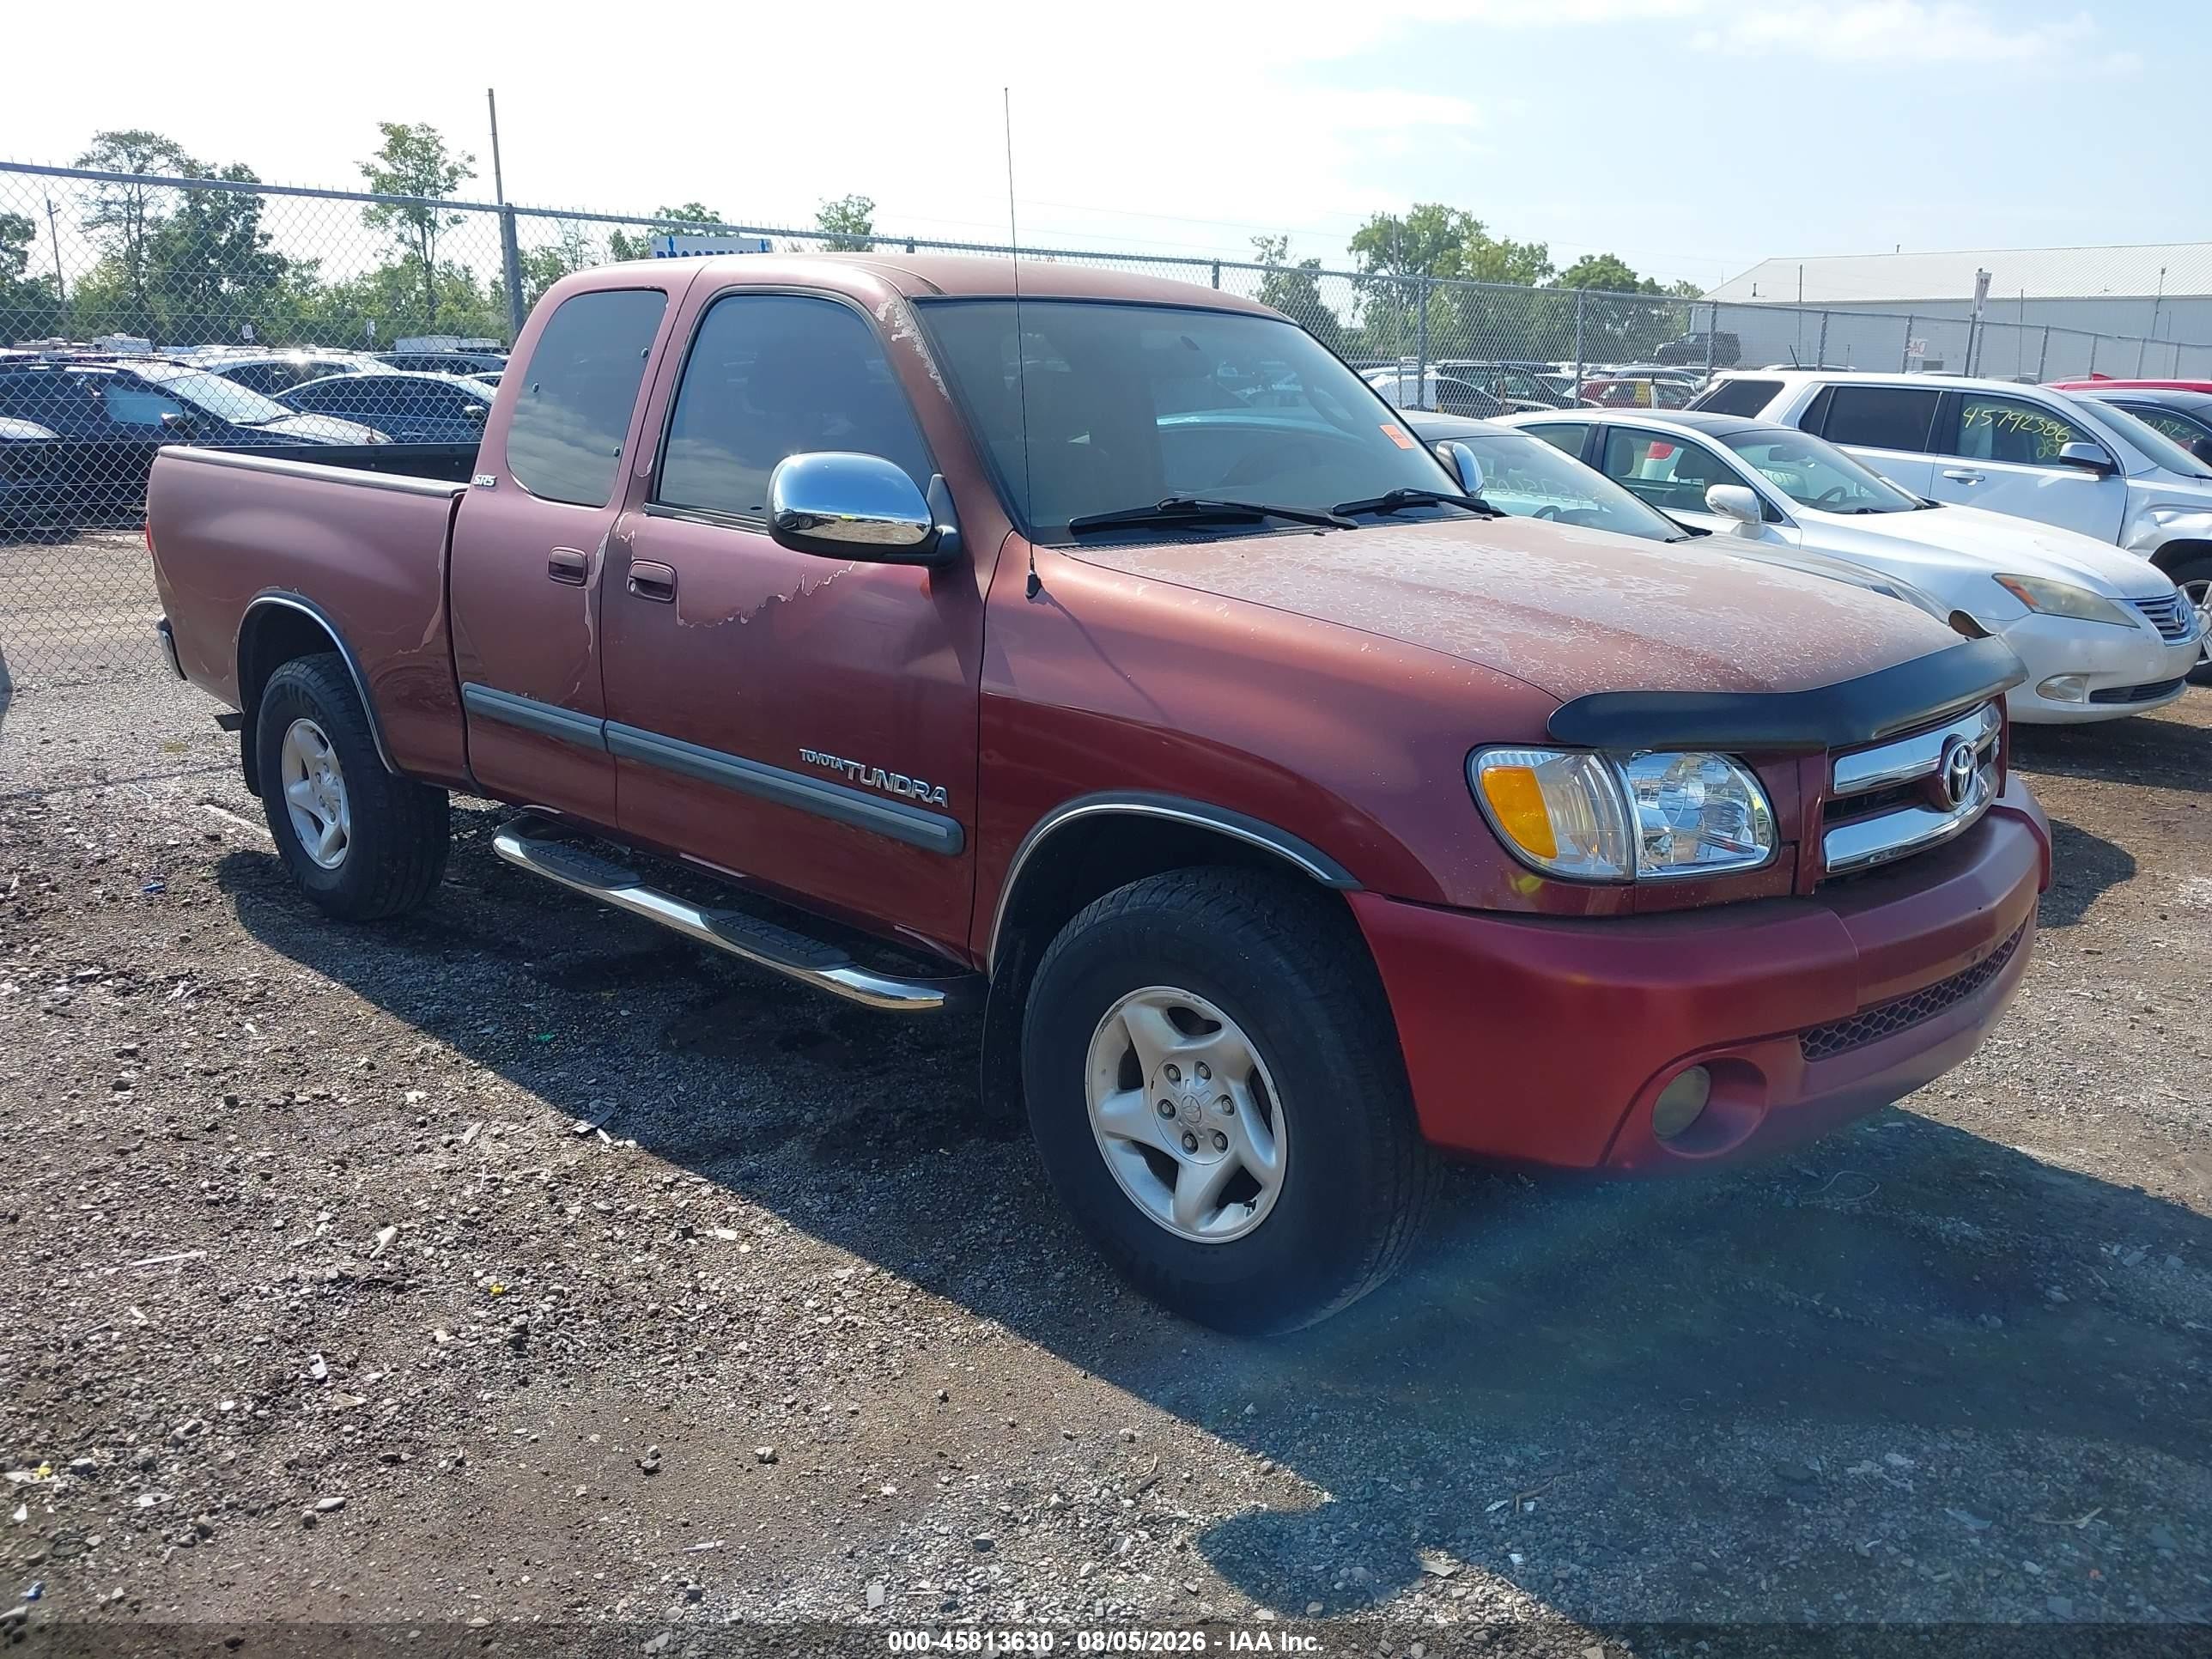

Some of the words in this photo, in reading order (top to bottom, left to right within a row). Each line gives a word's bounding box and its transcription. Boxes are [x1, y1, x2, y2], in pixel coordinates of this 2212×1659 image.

[1963, 406, 2070, 442] 45792386
[473, 474, 495, 487] SR5
[799, 748, 844, 771] TOYOTA
[843, 760, 949, 808] TUNDRA
